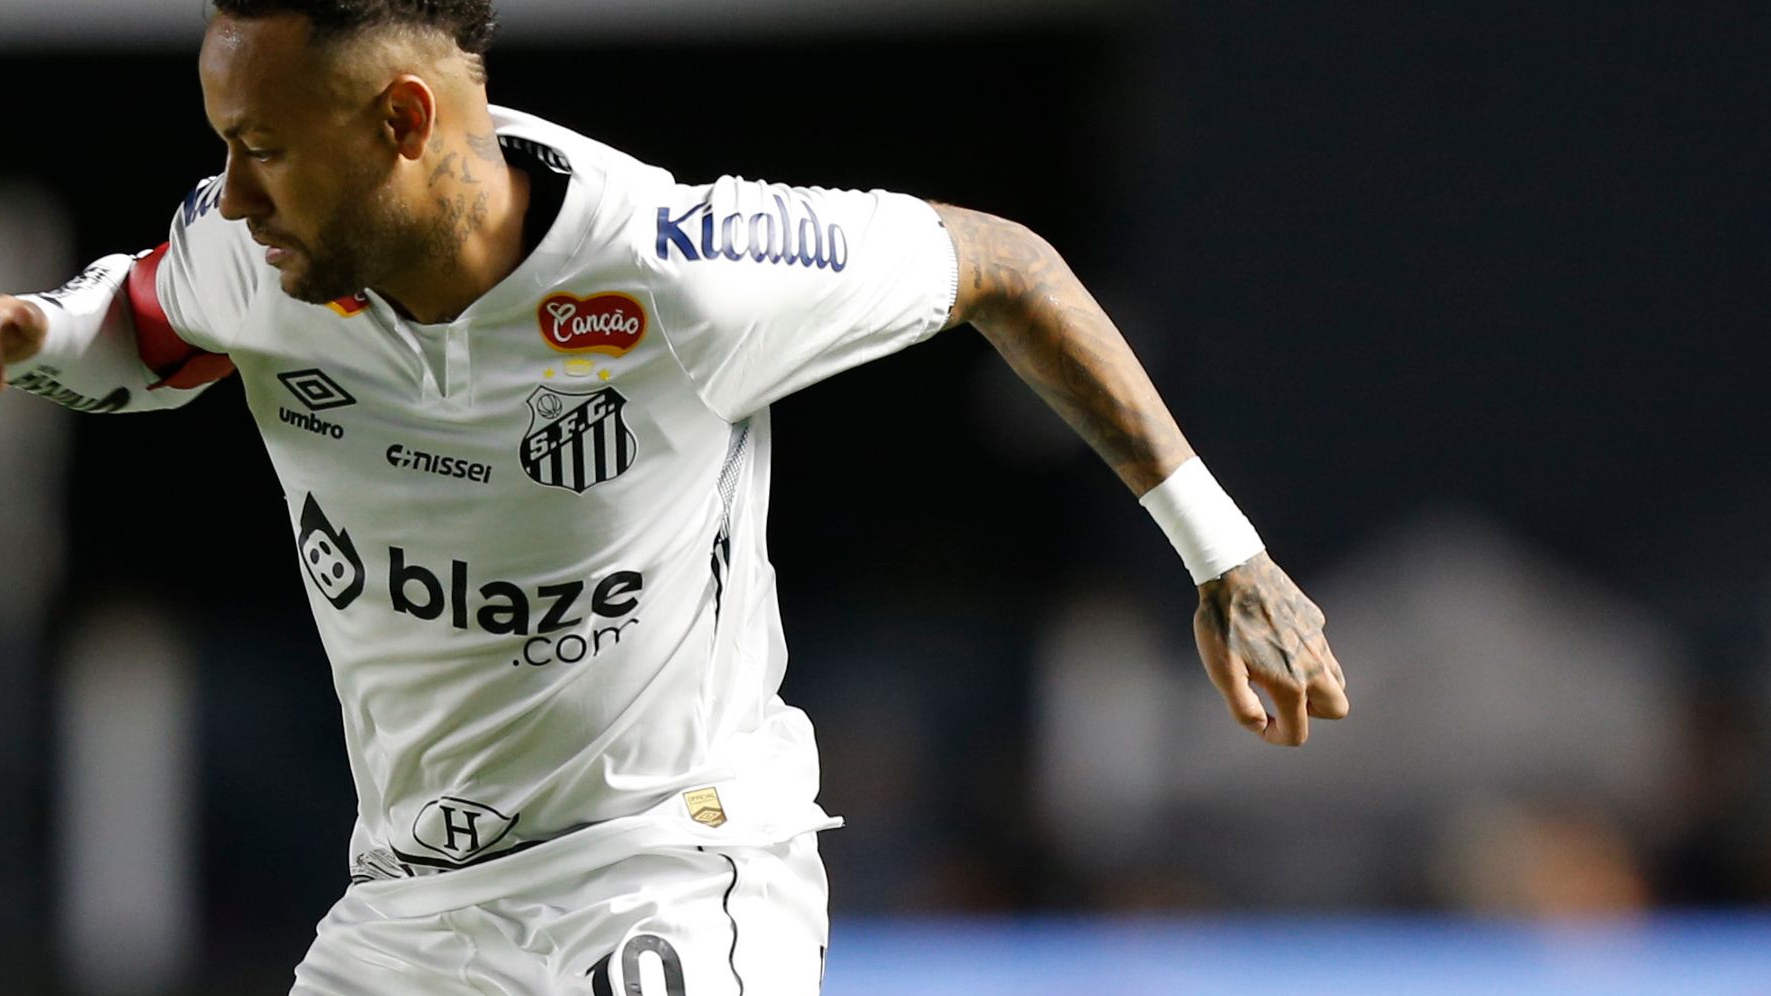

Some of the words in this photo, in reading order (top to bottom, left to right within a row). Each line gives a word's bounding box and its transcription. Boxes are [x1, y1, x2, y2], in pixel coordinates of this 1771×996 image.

[655, 193, 848, 273] Kicaldo
[546, 302, 640, 343] Canção
[278, 407, 344, 440] umbro
[410, 450, 493, 484] nissei
[388, 545, 643, 636] blaze
[512, 617, 640, 667] .com
[439, 805, 481, 853] H
